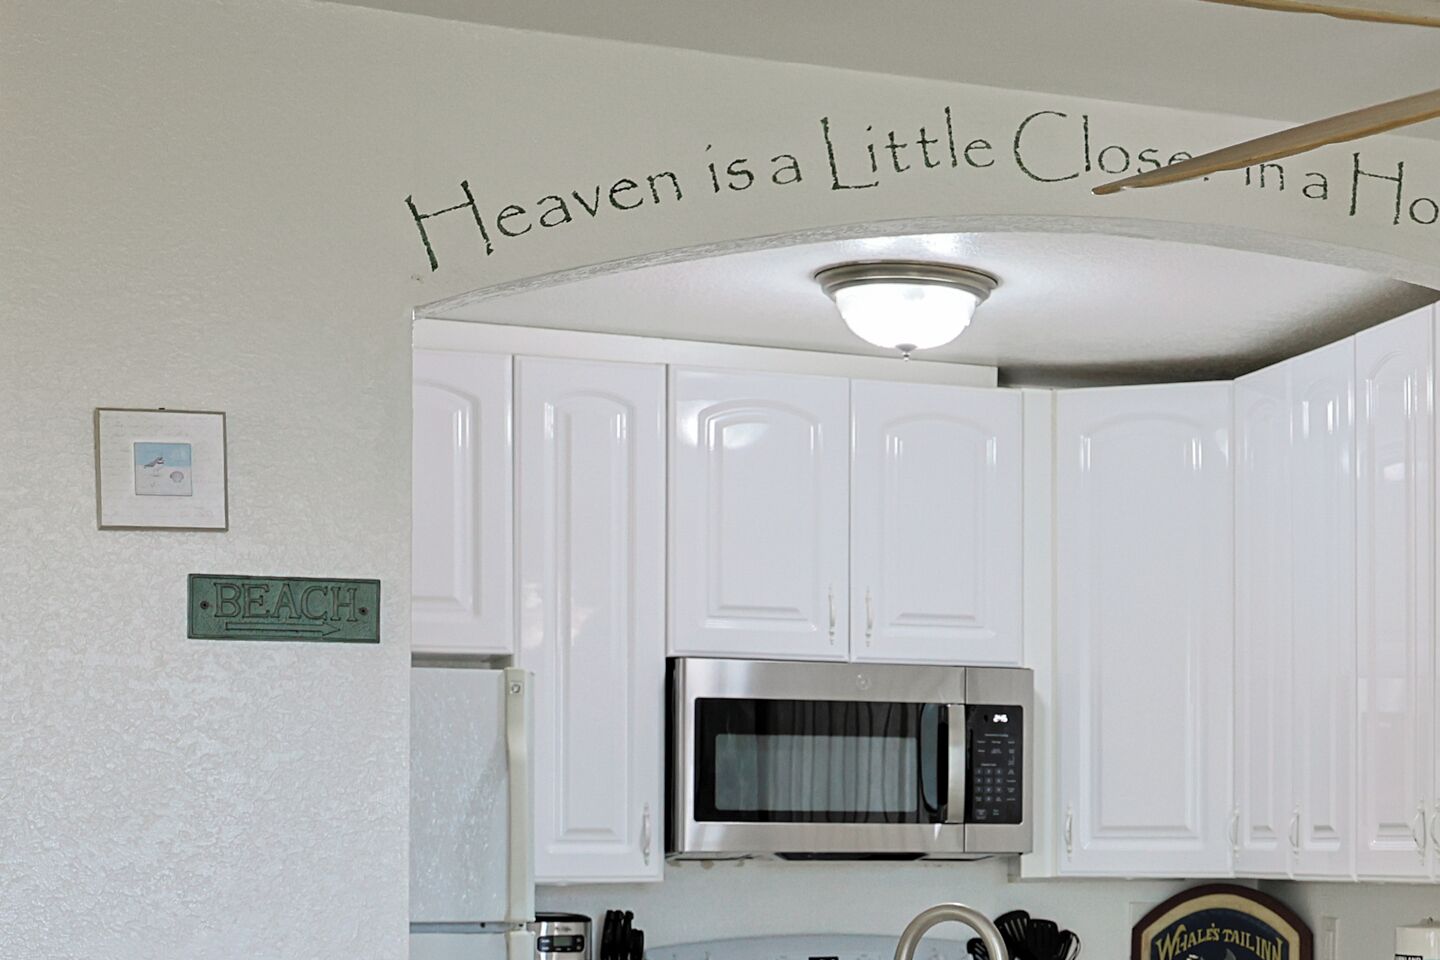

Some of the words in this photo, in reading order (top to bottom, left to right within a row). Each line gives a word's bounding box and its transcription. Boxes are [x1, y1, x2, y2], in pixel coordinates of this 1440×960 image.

[404, 171, 683, 272] Heaven
[704, 144, 754, 194] is
[771, 153, 803, 185] a
[820, 106, 995, 191] Little
[1013, 110, 1209, 183] Close
[1245, 163, 1284, 191] in
[1302, 171, 1329, 201] a
[213, 581, 358, 622] BEACH
[1222, 928, 1255, 951] TAIL
